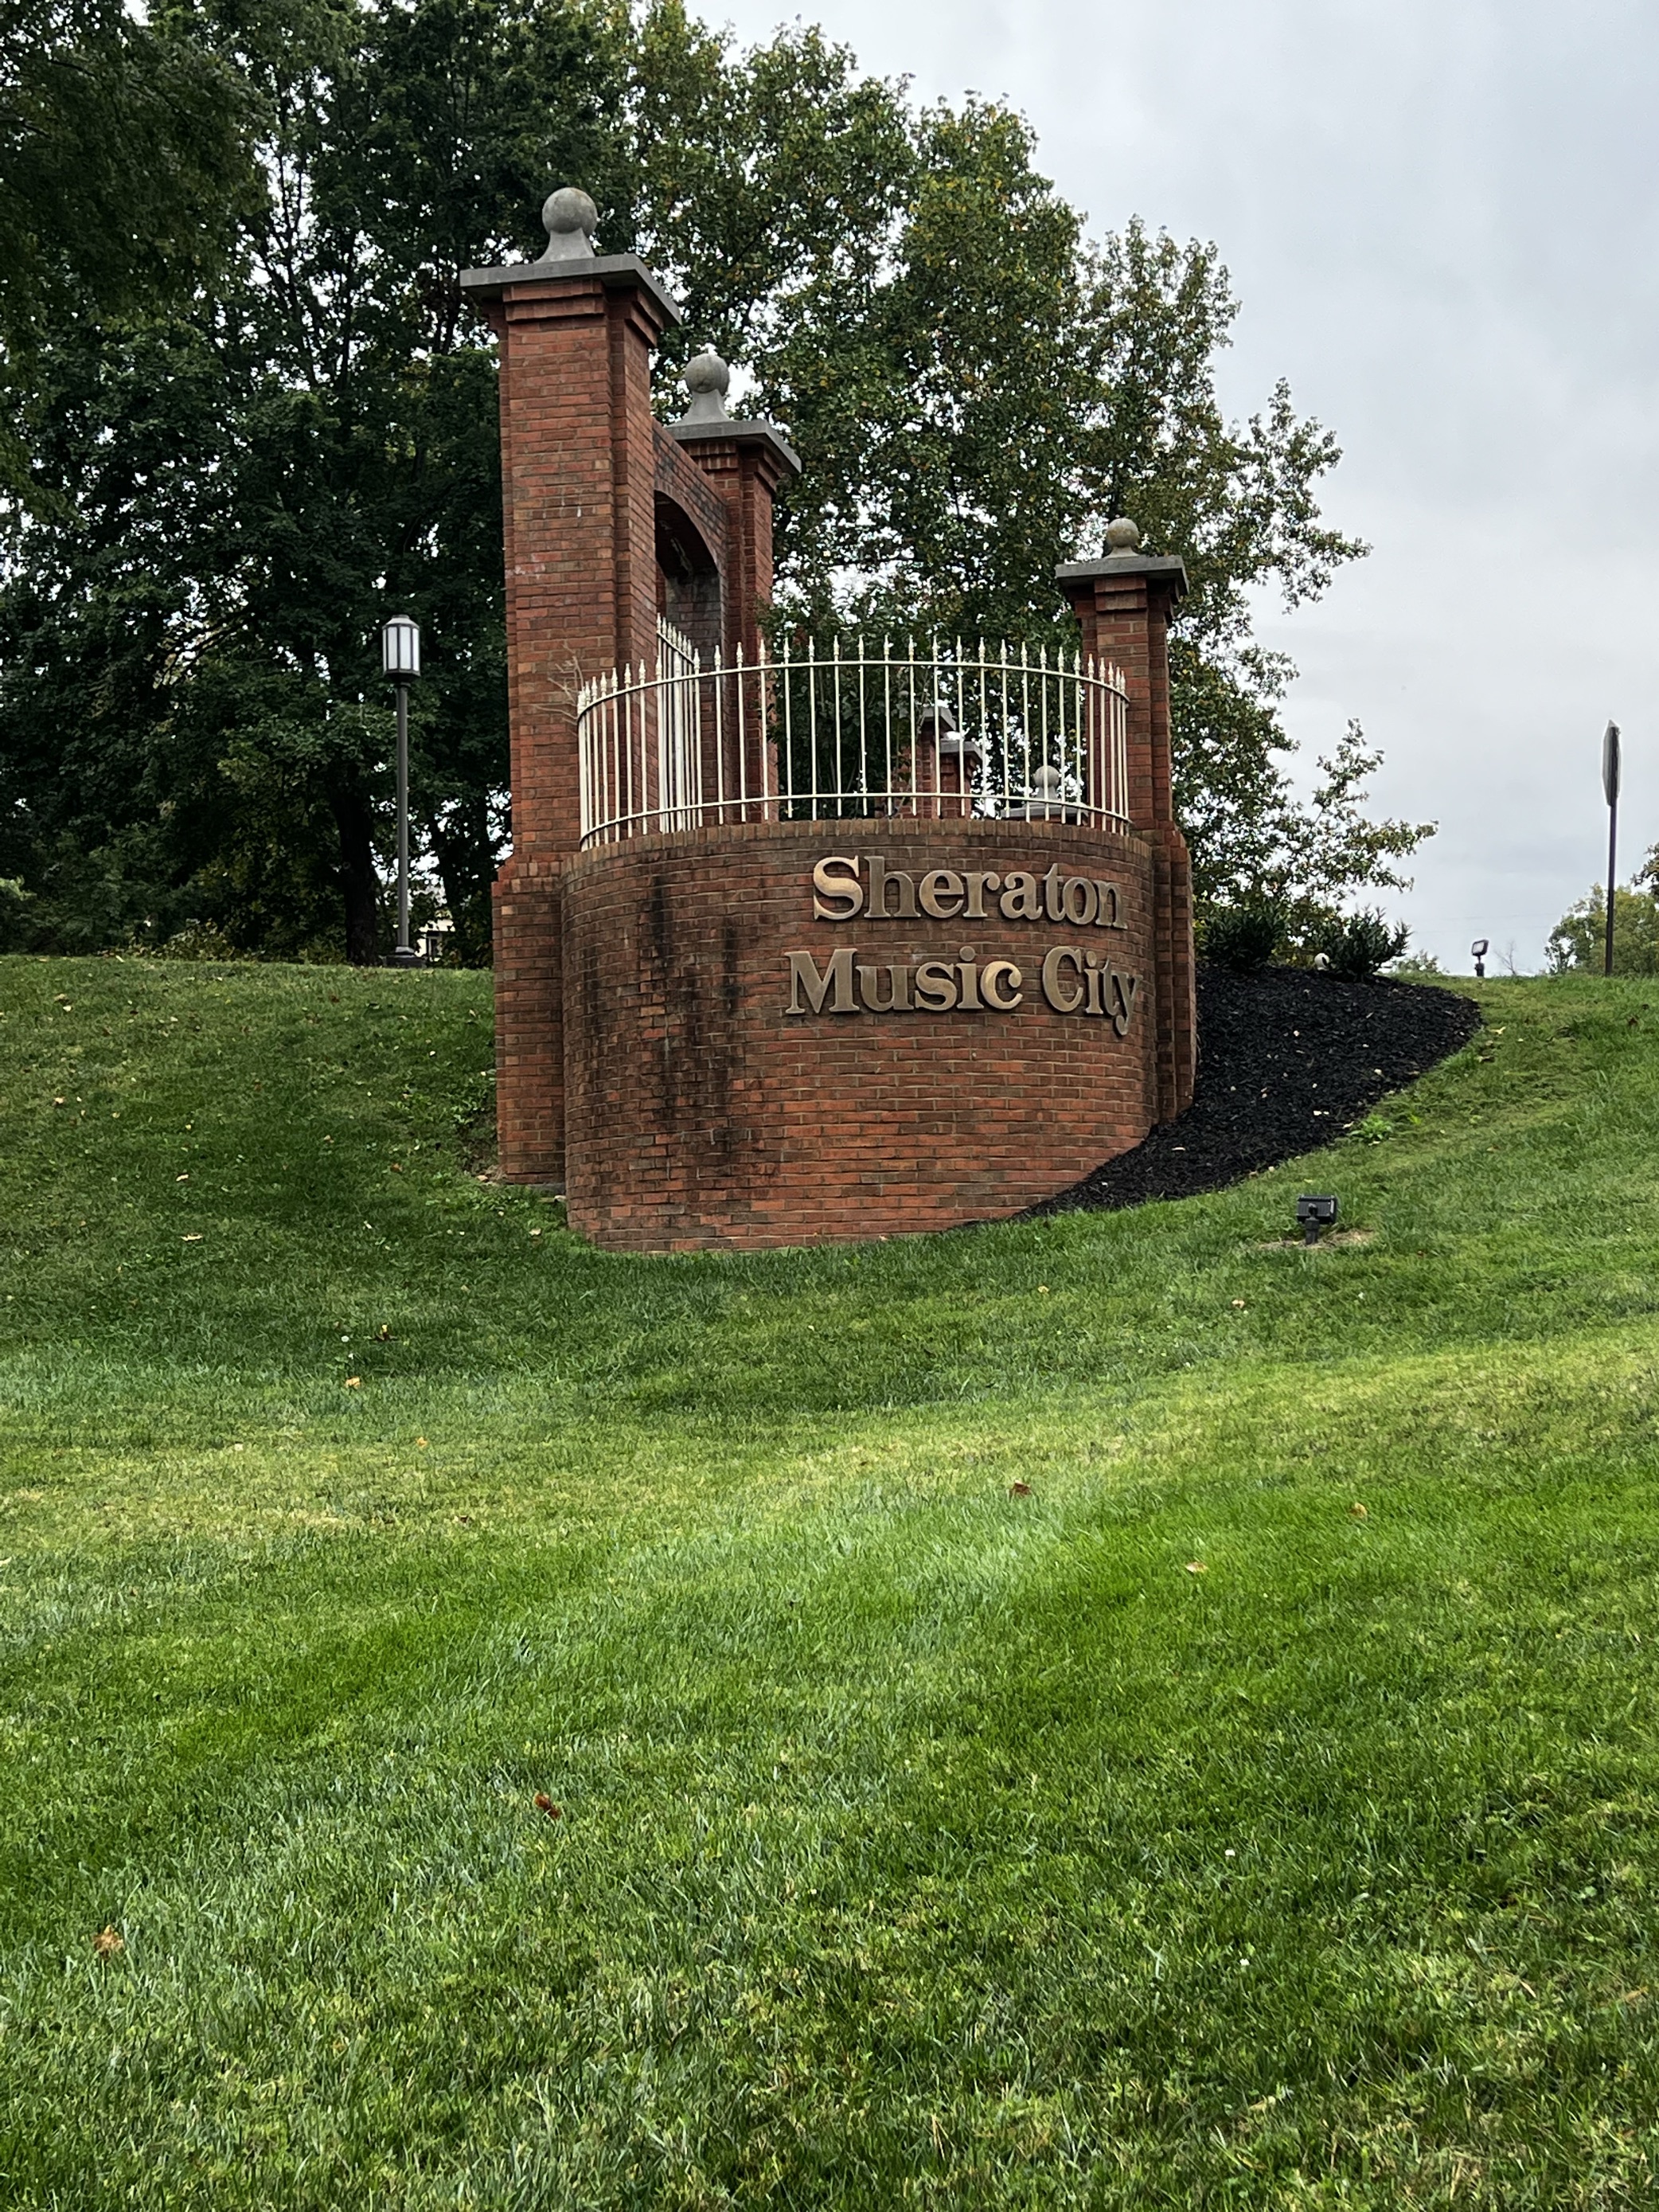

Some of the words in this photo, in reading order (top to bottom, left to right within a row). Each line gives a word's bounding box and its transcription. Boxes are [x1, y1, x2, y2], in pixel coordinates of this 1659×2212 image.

[813, 854, 1128, 930] Sheraton
[785, 946, 1024, 1014] Music
[1042, 945, 1143, 1036] City
